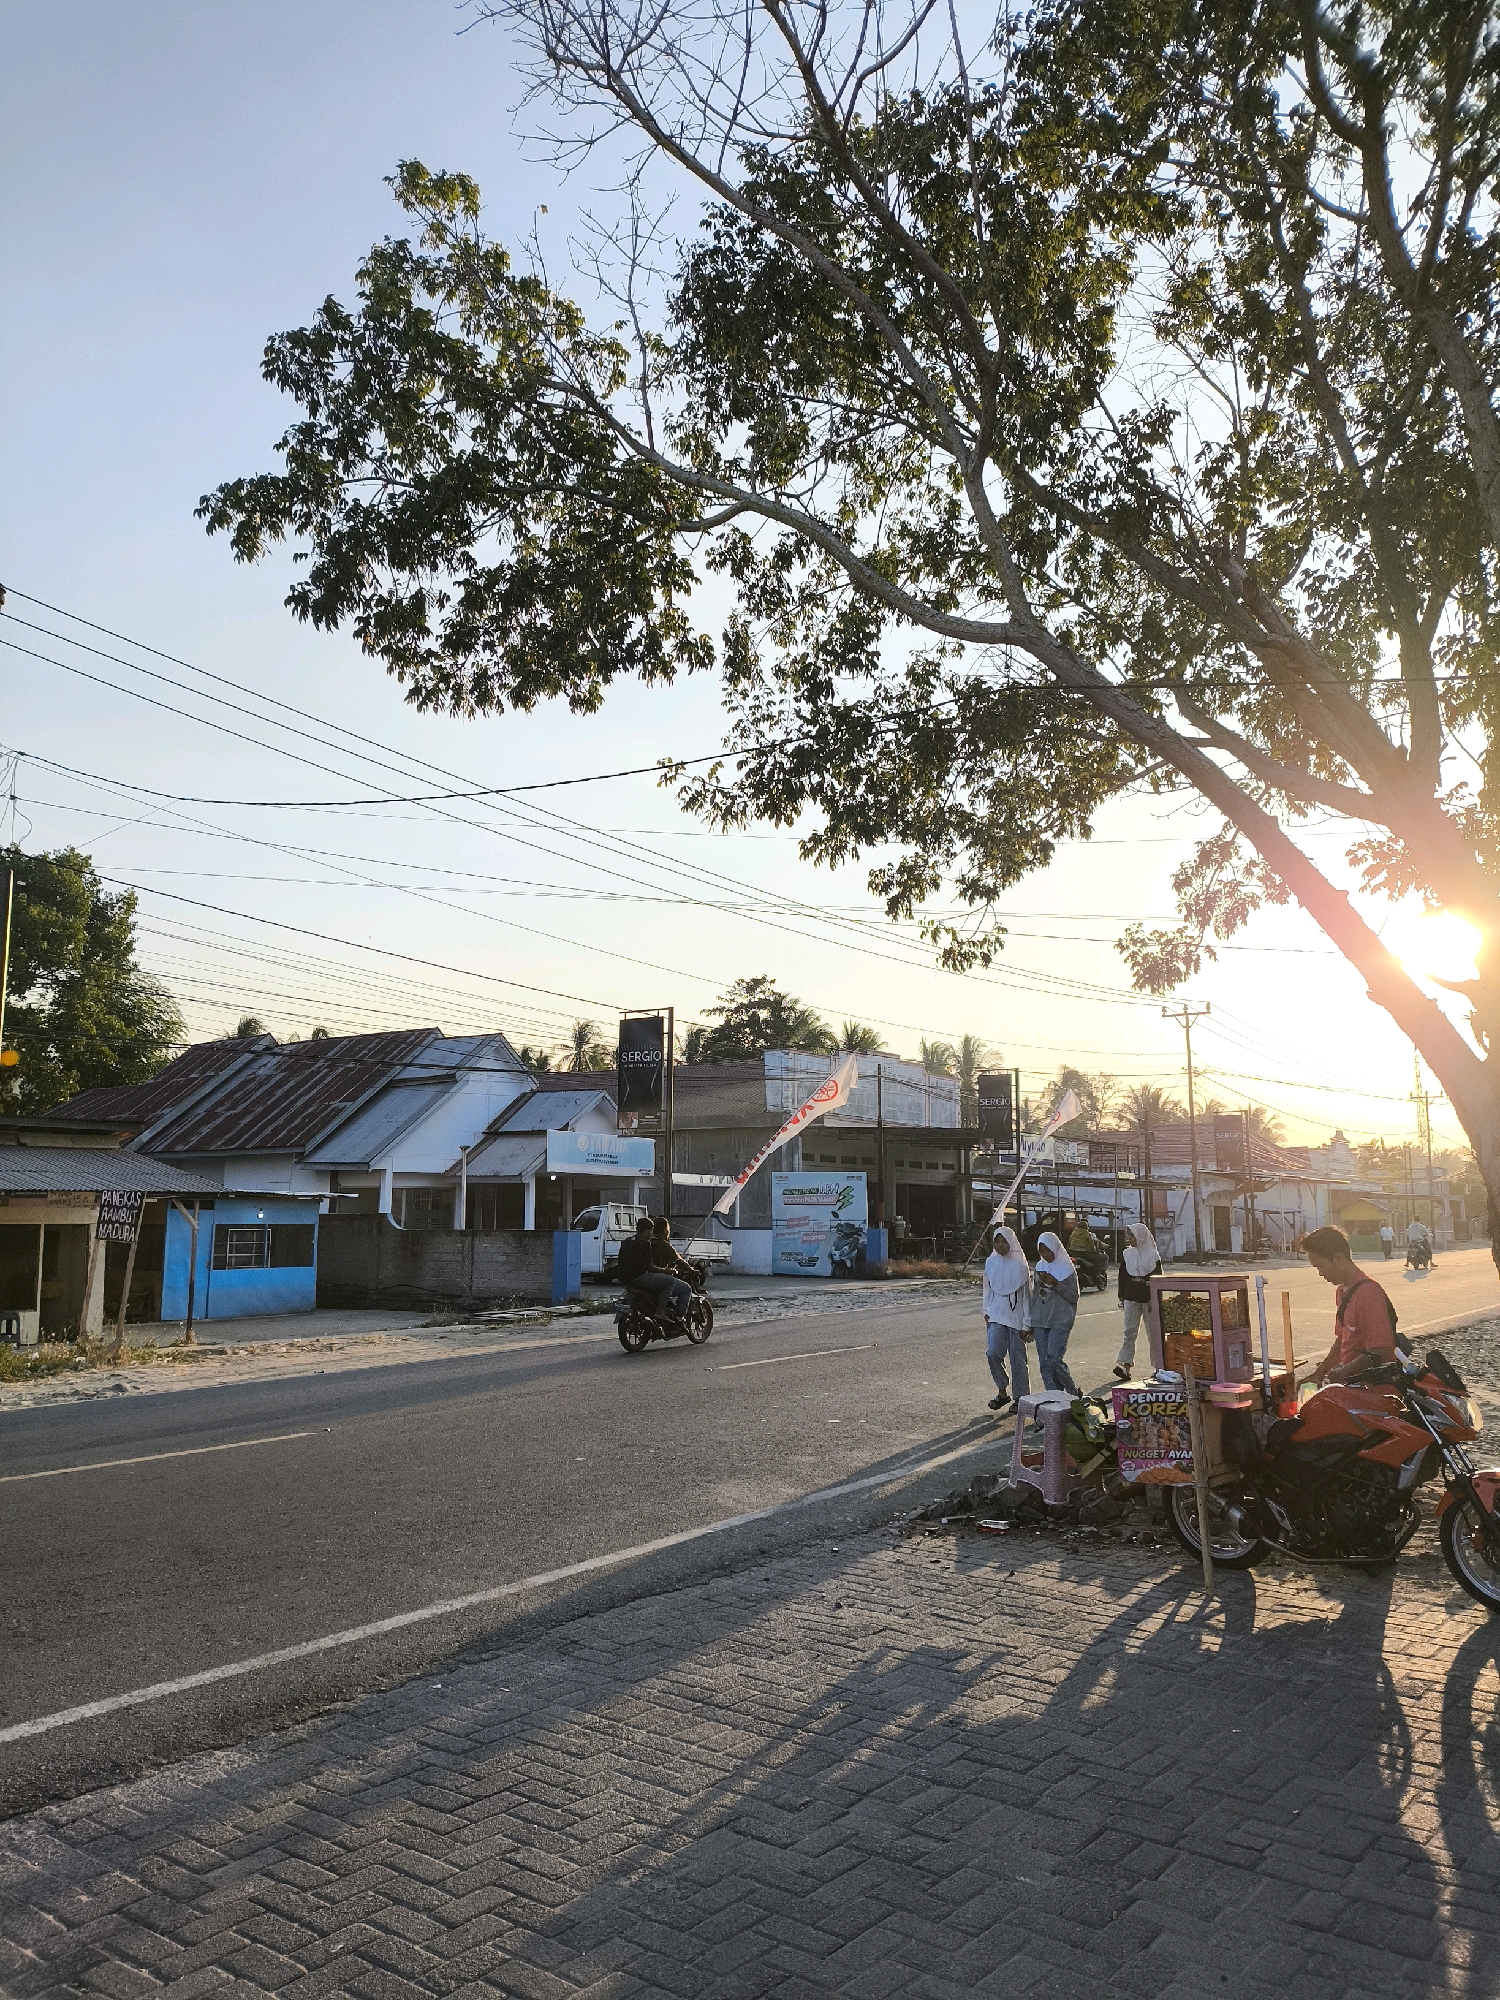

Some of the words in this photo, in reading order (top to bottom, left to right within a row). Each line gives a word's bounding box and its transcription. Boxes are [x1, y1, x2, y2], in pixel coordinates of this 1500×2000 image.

[621, 1050, 662, 1063] SERGIO
[979, 1097, 1011, 1106] SERGIO
[1215, 1131, 1242, 1139] SERGIO
[590, 1135, 629, 1153] YAMAHA
[101, 1190, 142, 1207] PANGKAS
[100, 1207, 138, 1224] RAMBUT
[97, 1223, 136, 1242] MADURA
[1129, 1392, 1184, 1403] PENTOL
[1123, 1402, 1190, 1418] KOREA
[1124, 1449, 1167, 1459] NUGGET
